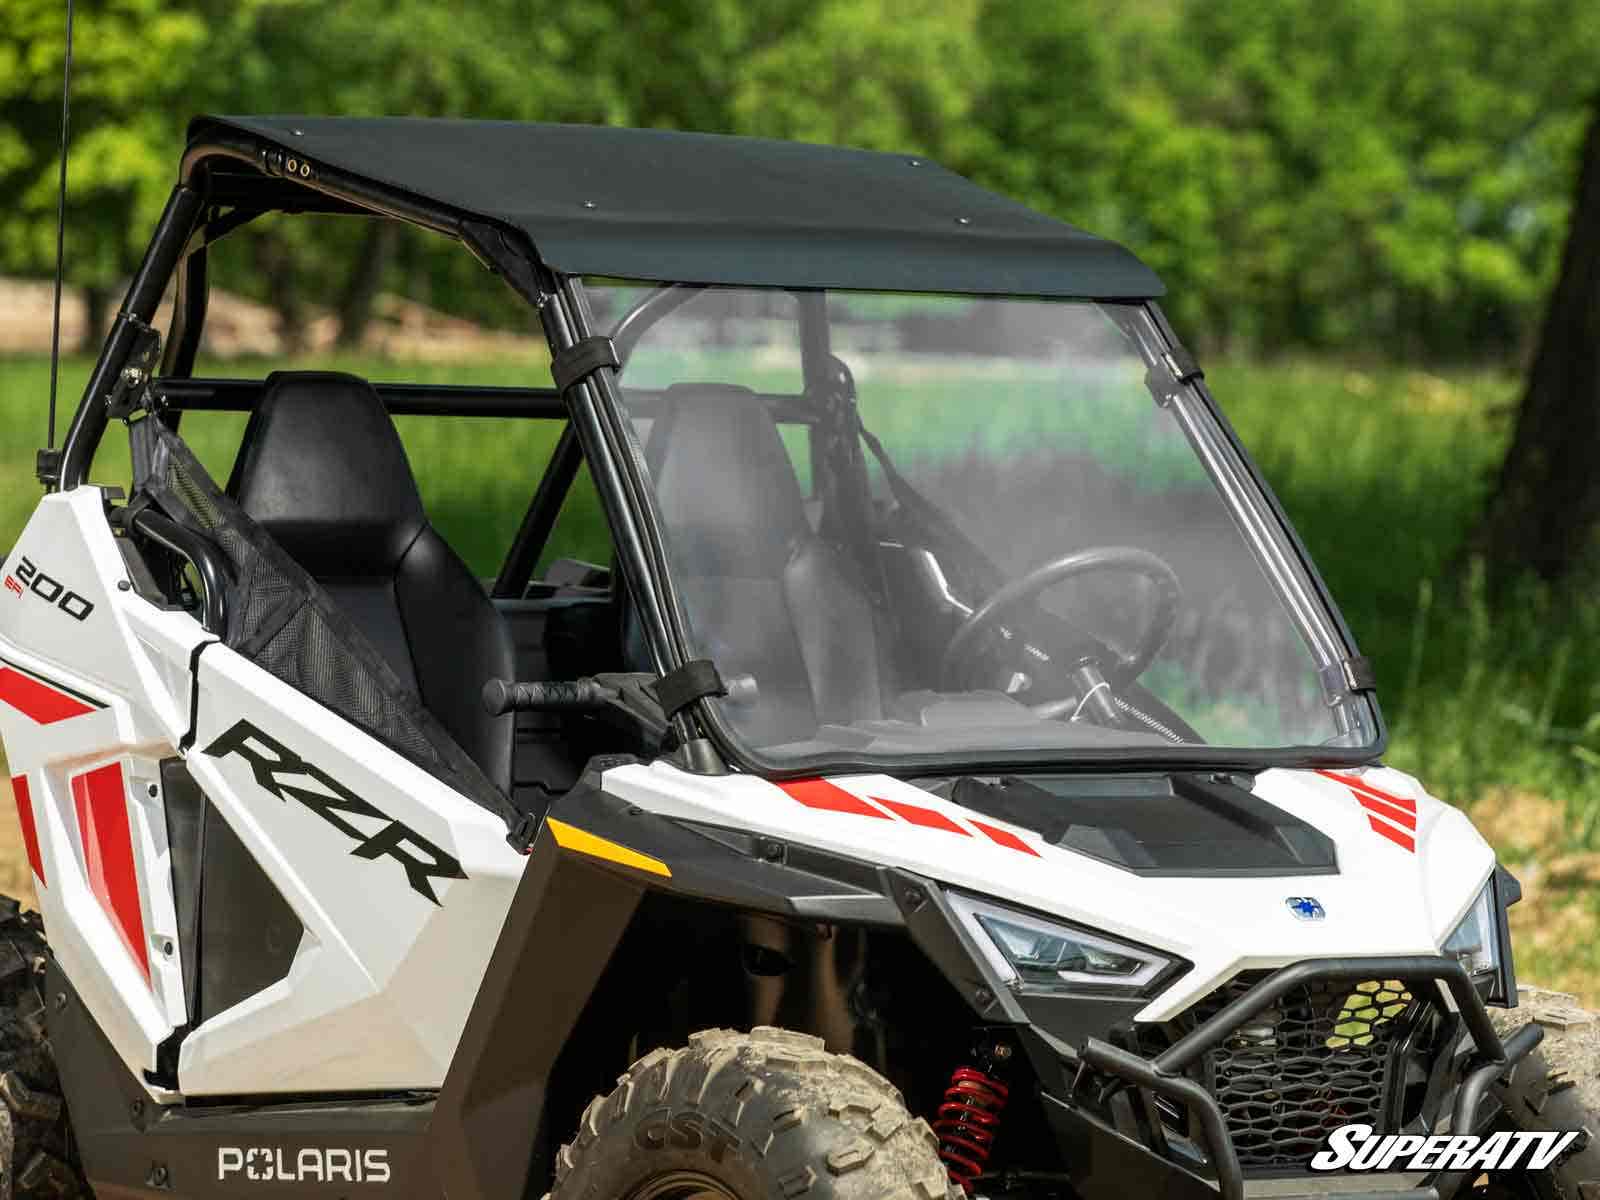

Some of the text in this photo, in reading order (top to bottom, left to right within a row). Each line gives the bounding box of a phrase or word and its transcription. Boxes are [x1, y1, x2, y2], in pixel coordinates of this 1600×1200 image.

[16, 555, 95, 621] 200
[200, 718, 470, 908] RZR
[217, 1146, 392, 1183] POLARIS
